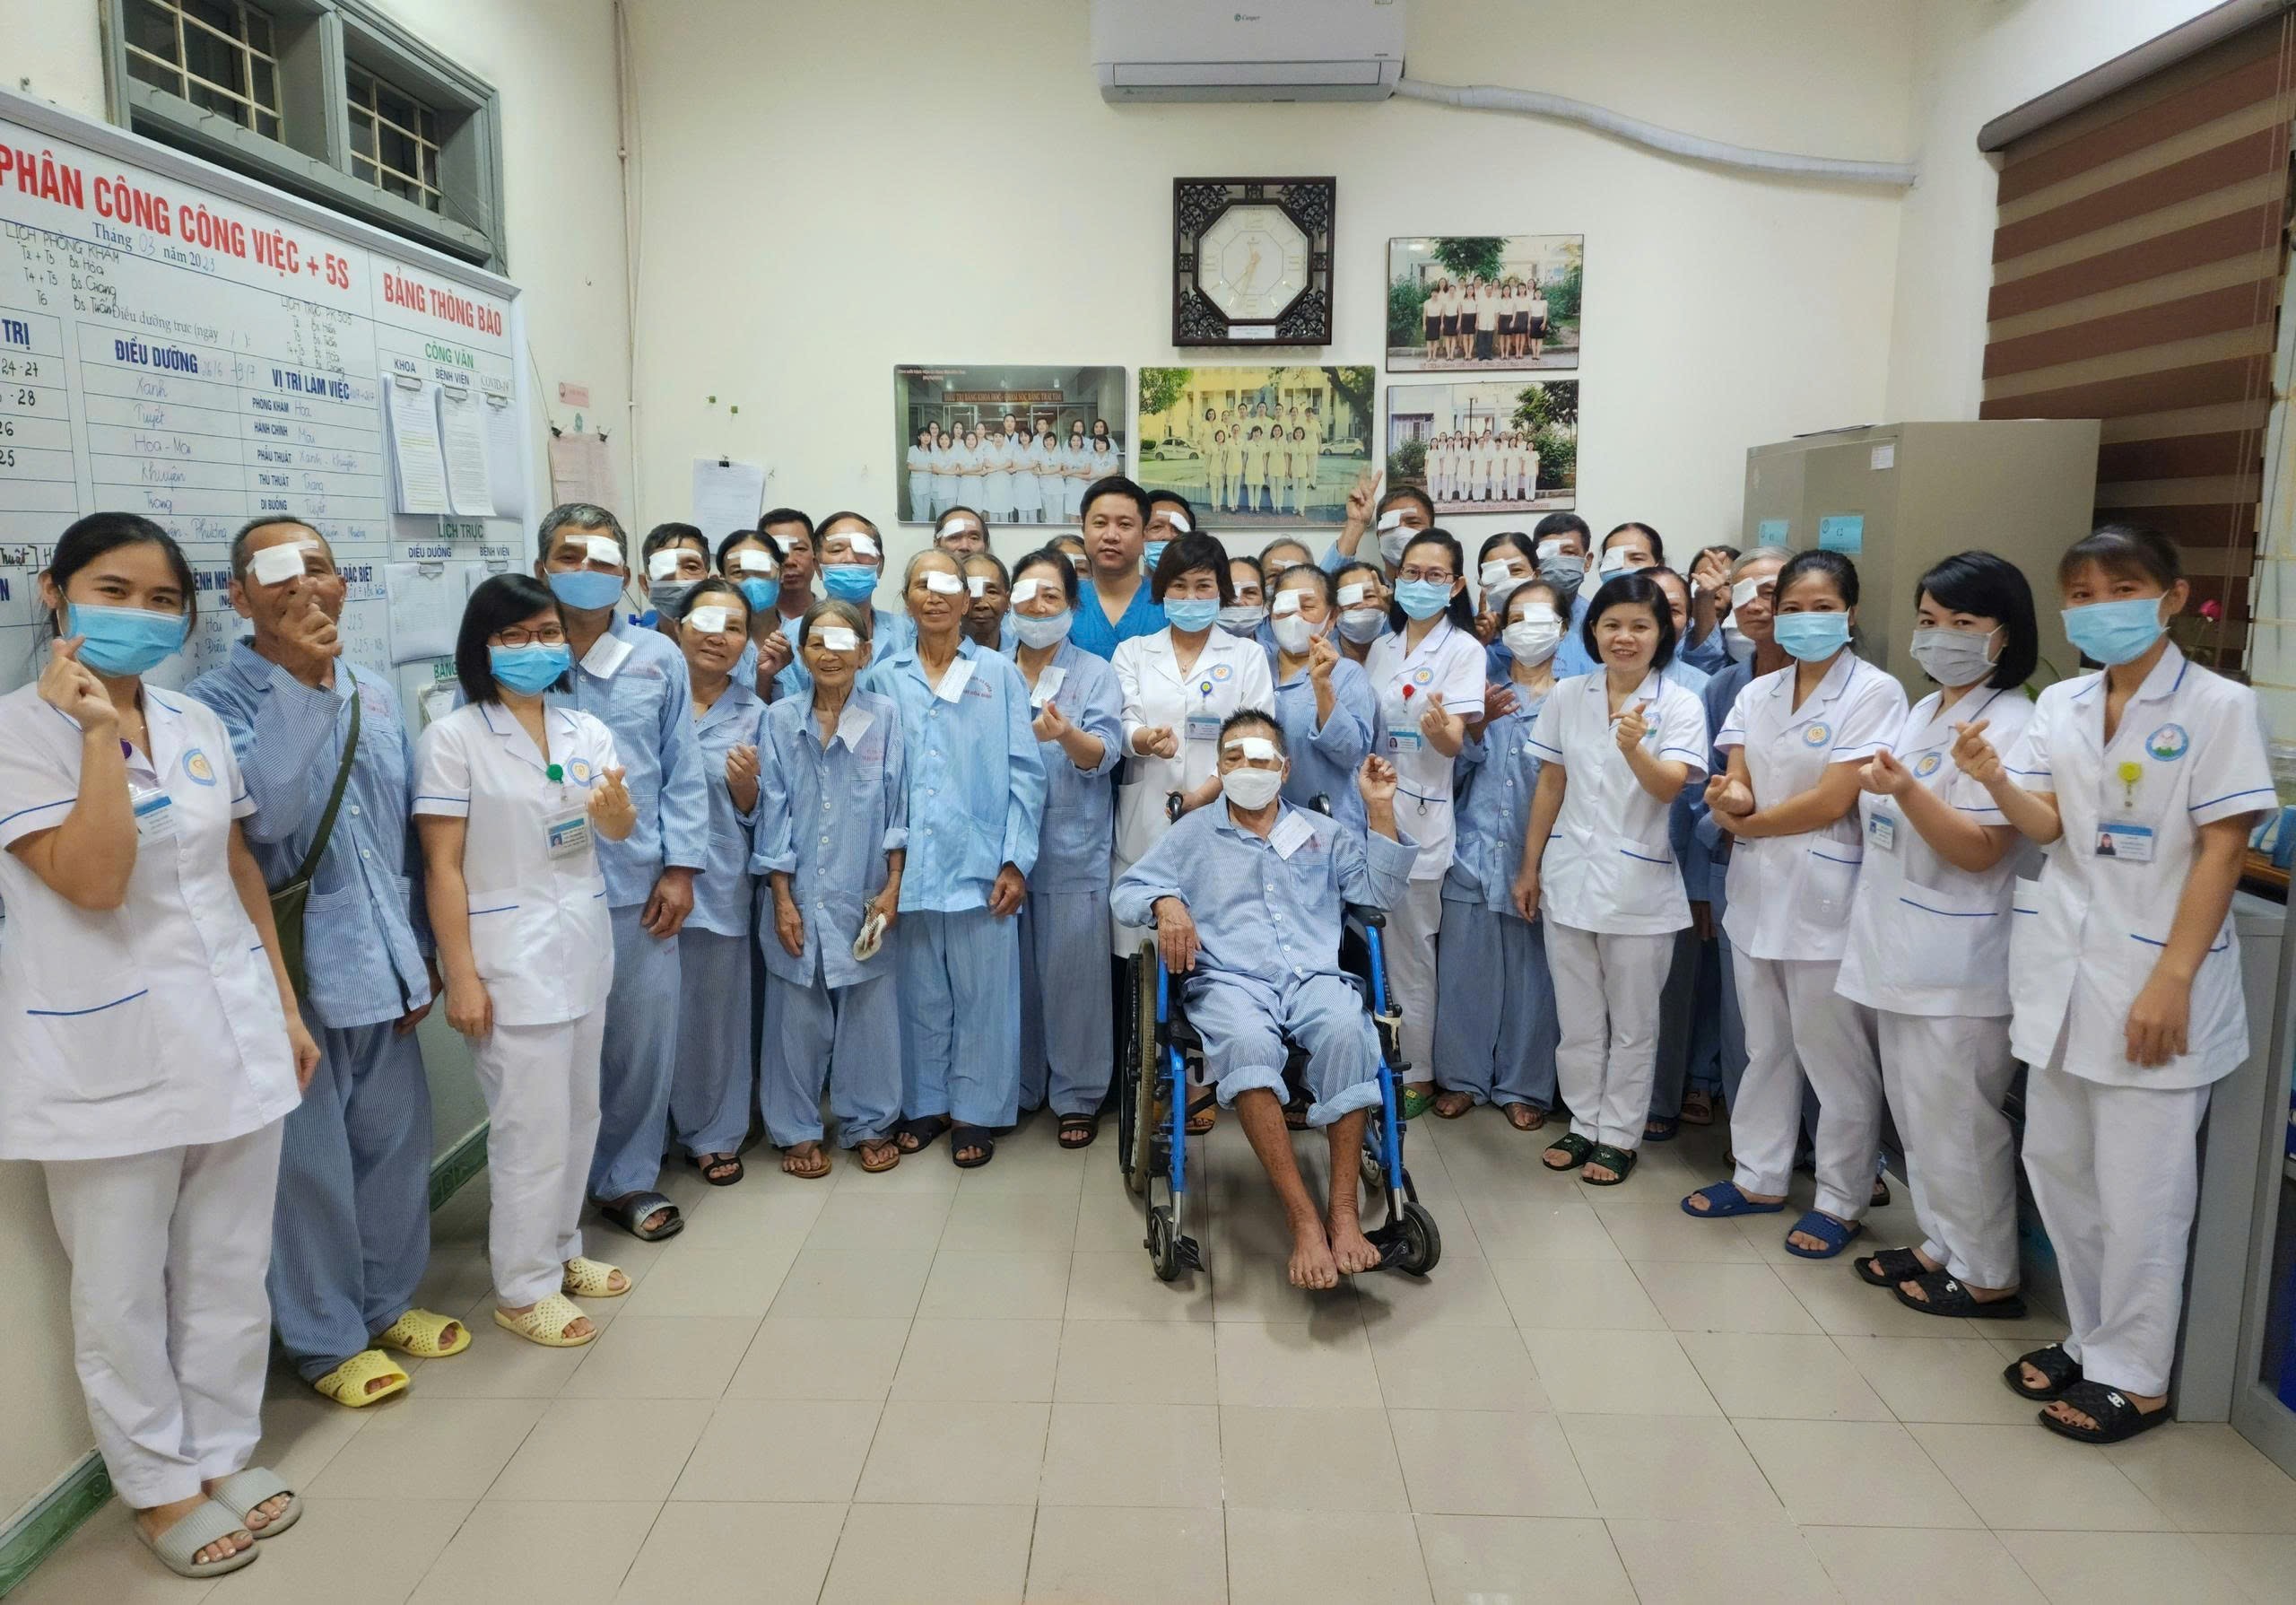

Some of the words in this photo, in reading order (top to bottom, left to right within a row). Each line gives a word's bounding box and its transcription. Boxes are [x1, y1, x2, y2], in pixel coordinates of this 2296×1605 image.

[0, 144, 84, 210] PHÂN
[93, 175, 171, 237] CÔNG
[178, 203, 247, 258] CÔNG
[251, 229, 300, 277] VIỆC
[325, 253, 350, 290] 5S
[92, 222, 133, 252] Tháng
[162, 246, 187, 265] năm
[383, 265, 426, 313] BẢNG
[429, 287, 474, 329] THÔNG
[477, 302, 502, 337] BÁO
[2, 318, 30, 351] TRỊ
[115, 336, 148, 365] ĐIỀU
[152, 345, 198, 374] DƯỠNG
[394, 359, 417, 374] KHOA
[424, 341, 452, 364] CÔNG
[454, 345, 474, 370] VĂN
[272, 369, 283, 392] VỊ
[285, 370, 302, 391] TRÍ
[304, 373, 326, 396] LÀM
[328, 379, 350, 403] VIỆC
[435, 367, 453, 382] BỆNH
[455, 371, 470, 387] VIỆN
[18, 388, 36, 406] 28
[252, 396, 272, 412] PHÒNG
[273, 398, 289, 414] KHÁM
[254, 419, 270, 434] HÀNH
[271, 421, 288, 437] CHÍNH
[438, 523, 458, 541] LỊCH
[460, 523, 484, 542] TRỰC
[408, 542, 425, 558] ĐIỀU
[427, 544, 452, 558] DƯỠNG
[479, 545, 496, 558] BỆNH
[192, 567, 213, 596] ỆNH
[214, 566, 234, 590] NHÂ
